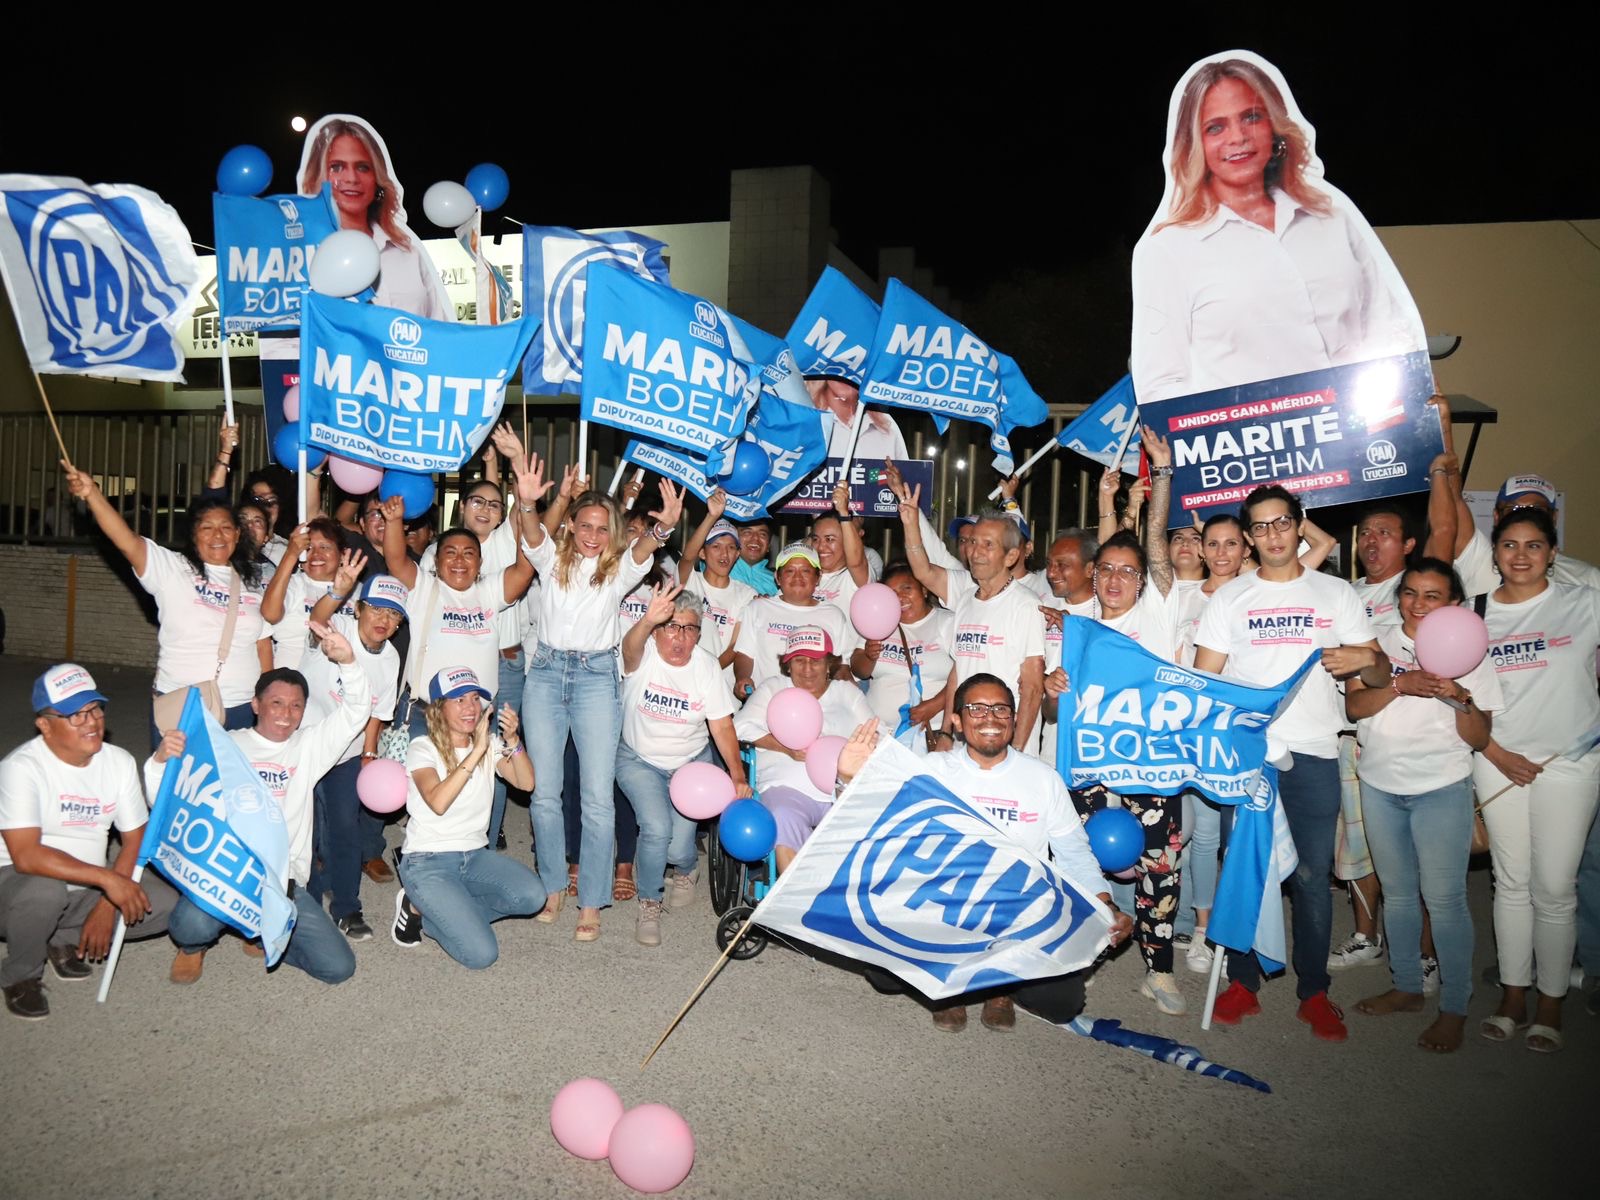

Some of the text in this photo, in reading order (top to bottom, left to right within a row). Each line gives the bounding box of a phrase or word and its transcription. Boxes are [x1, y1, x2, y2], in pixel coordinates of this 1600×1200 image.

[243, 286, 300, 314] BOE
[699, 307, 716, 325] PAN
[394, 322, 418, 341] PAN
[766, 366, 788, 382] YUCAT
[898, 359, 1000, 398] BOEH
[626, 372, 738, 432] BOEH
[870, 385, 932, 405] DIPUTADA
[932, 398, 969, 413] LOCAL
[1177, 393, 1324, 429] UNIDOS GANA MÉRIDA
[598, 403, 664, 430] DIPUTADA
[667, 420, 711, 446] LOCAL
[315, 427, 376, 455] DIPUTADA
[374, 448, 420, 467] LOCAL
[1173, 406, 1343, 467] MARITÉ
[1370, 444, 1393, 462] PAN
[637, 446, 688, 477] DIPUTADA
[689, 473, 715, 496] LOC
[1200, 448, 1325, 489] BOEHM
[1366, 464, 1404, 479] YUCATÁN
[881, 491, 893, 502] PAN
[1185, 491, 1241, 506] DIPUTADA
[1283, 476, 1333, 491] DISTRITO
[1335, 474, 1344, 483] 3
[443, 611, 486, 623] MARITÉ
[1248, 613, 1315, 630] MARITÉ
[956, 632, 988, 645] MARTÉ
[1258, 628, 1305, 639] BOEHM
[882, 643, 923, 656] MARTÉ
[1489, 638, 1546, 658] ARITÉ
[1494, 652, 1538, 667] OEHM
[643, 689, 689, 711] MARITÉ
[643, 702, 682, 718] BOEHM
[1136, 768, 1189, 783] LOCAL
[167, 807, 267, 897] BOEH
[869, 817, 1052, 938] PAN
[183, 866, 261, 927] LOCAL DIST
